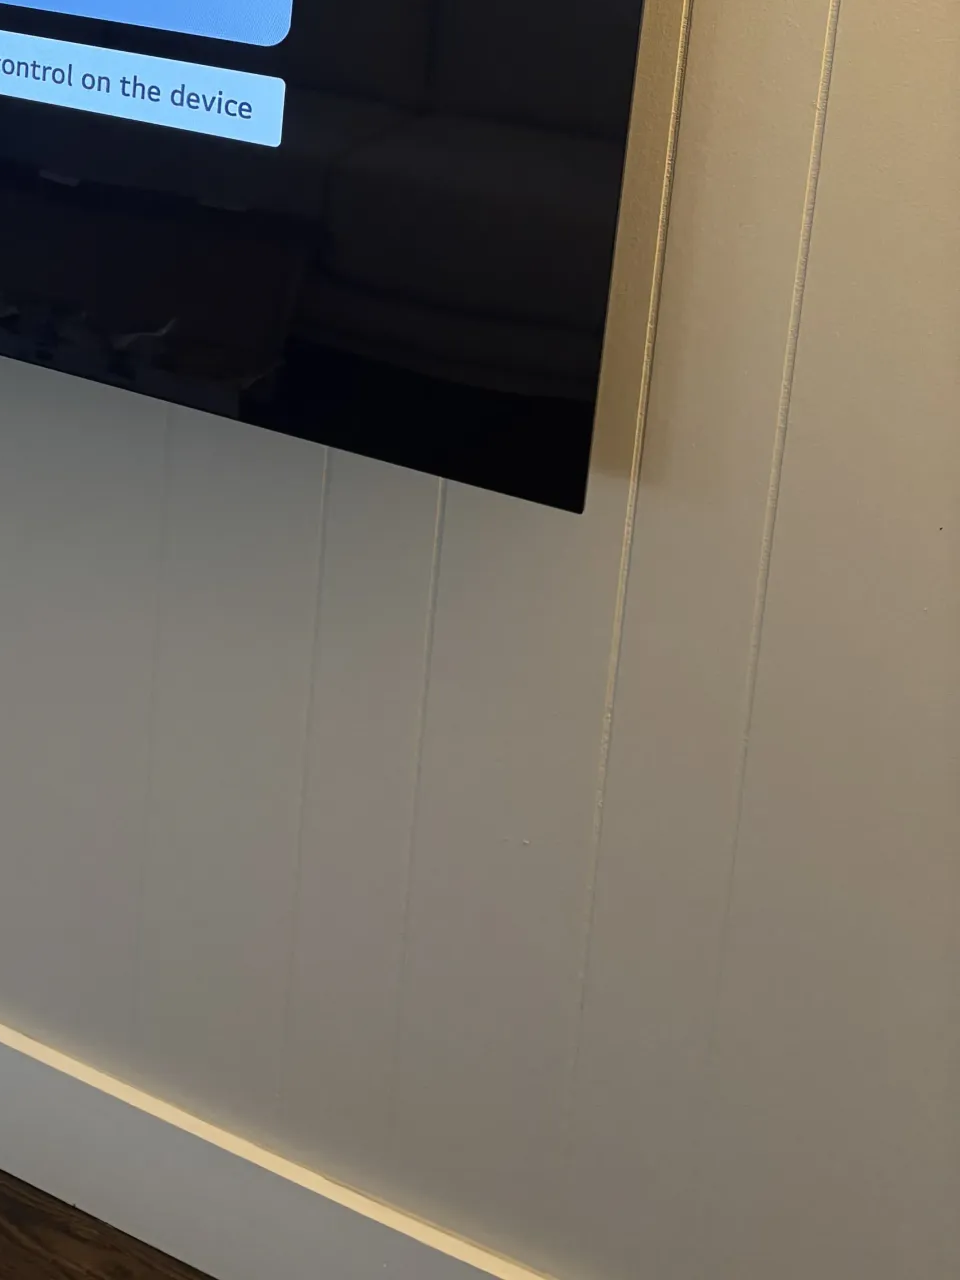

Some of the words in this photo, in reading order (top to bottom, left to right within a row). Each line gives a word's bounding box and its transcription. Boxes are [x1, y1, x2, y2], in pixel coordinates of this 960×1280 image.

[81, 73, 111, 94] on
[119, 76, 162, 103] the
[170, 83, 253, 120] device
